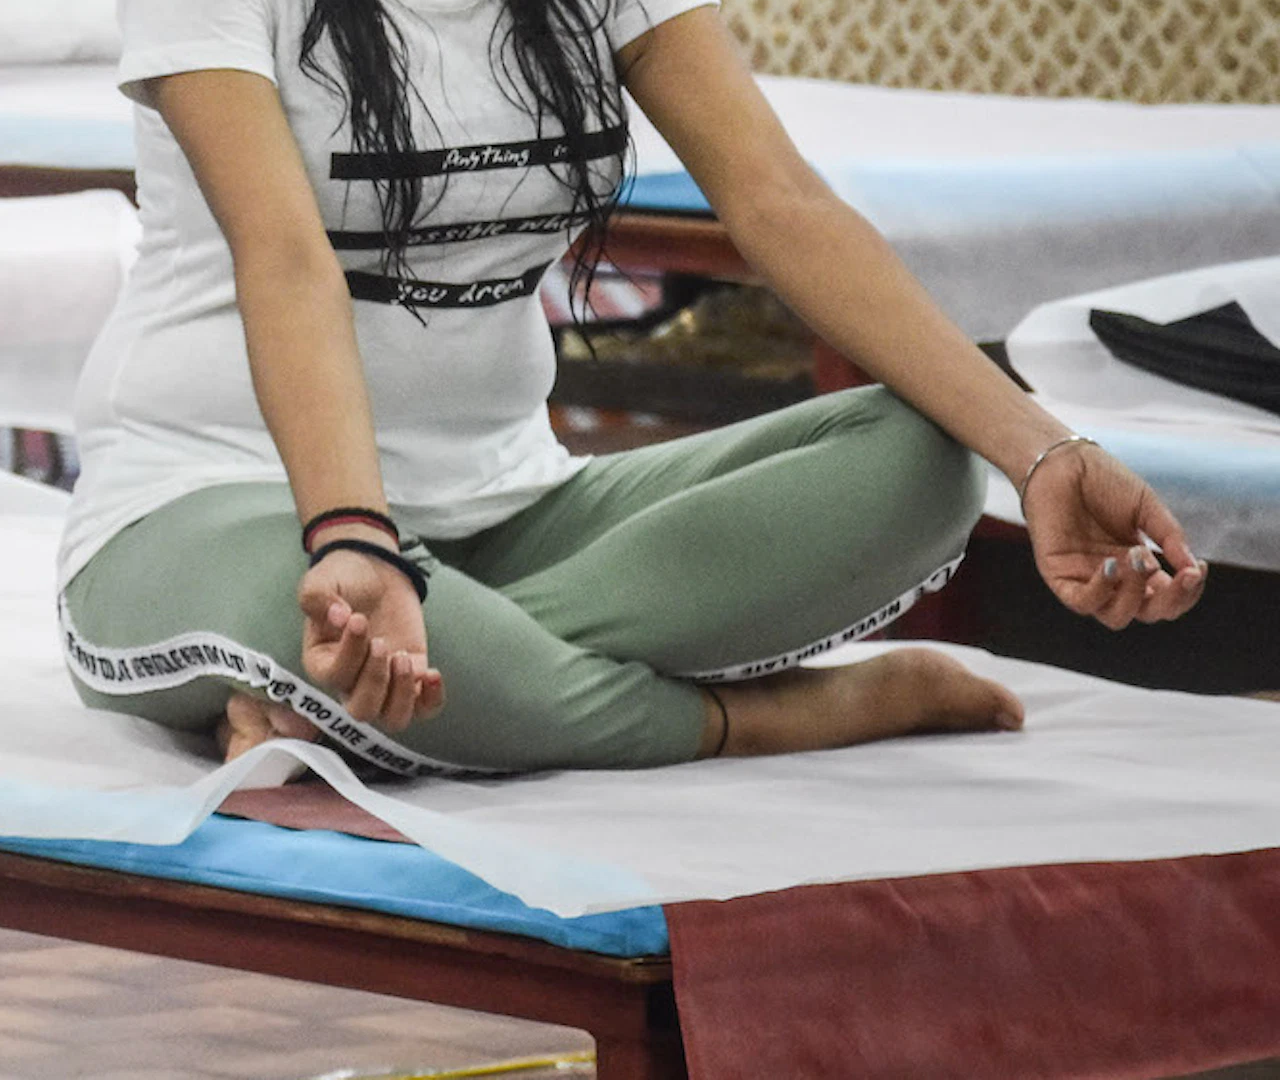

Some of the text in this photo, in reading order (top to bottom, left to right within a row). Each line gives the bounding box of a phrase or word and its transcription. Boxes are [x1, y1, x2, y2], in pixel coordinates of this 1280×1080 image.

[406, 222, 507, 245] ossible
[298, 694, 332, 721] TOO
[329, 717, 369, 747] LATE
